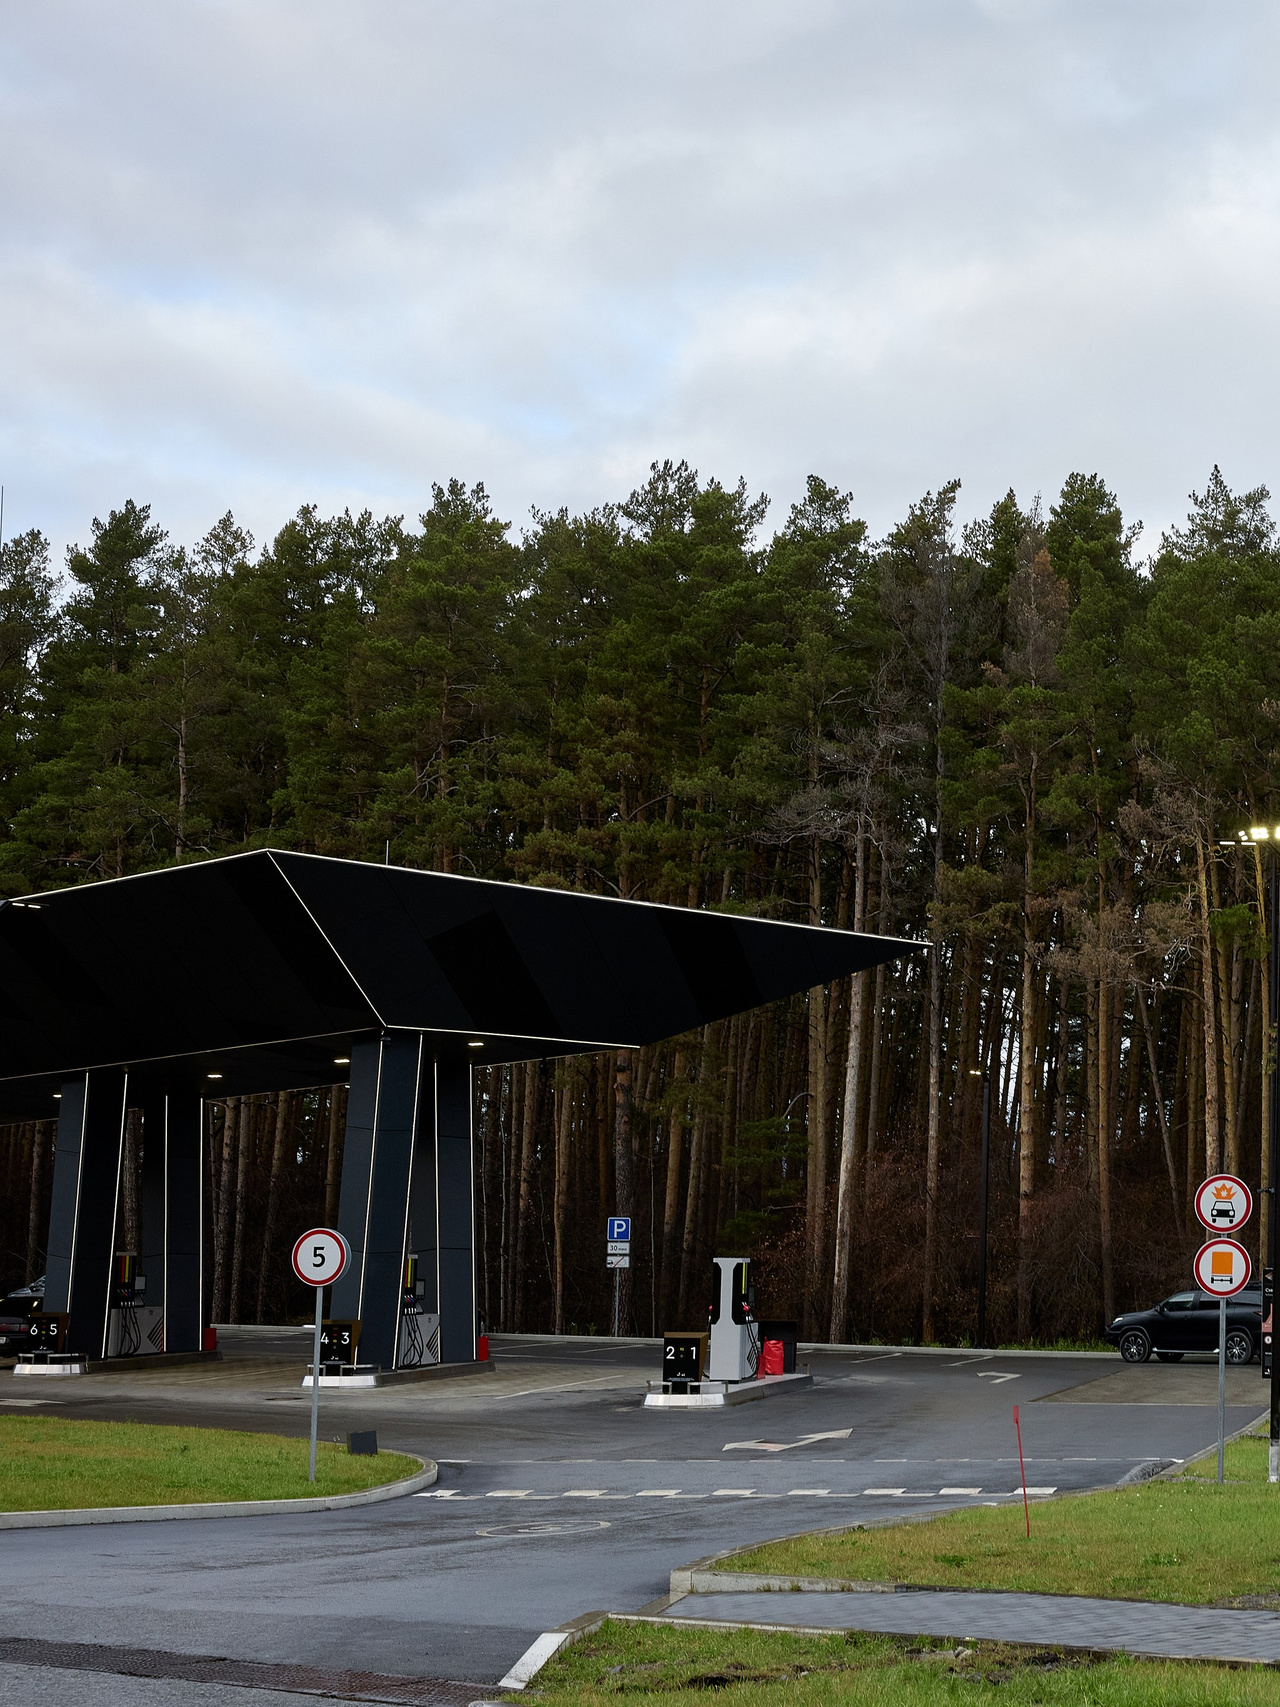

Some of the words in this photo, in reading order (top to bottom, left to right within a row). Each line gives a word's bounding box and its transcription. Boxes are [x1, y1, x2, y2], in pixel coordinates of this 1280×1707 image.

[613, 1220, 626, 1238] P
[610, 1244, 618, 1252] 30
[312, 1246, 326, 1268] 5
[30, 1324, 38, 1336] 6
[49, 1324, 57, 1336] 5
[320, 1332, 329, 1345] 4
[341, 1332, 350, 1345] 3
[666, 1346, 675, 1359] 2
[690, 1346, 696, 1360] 1
